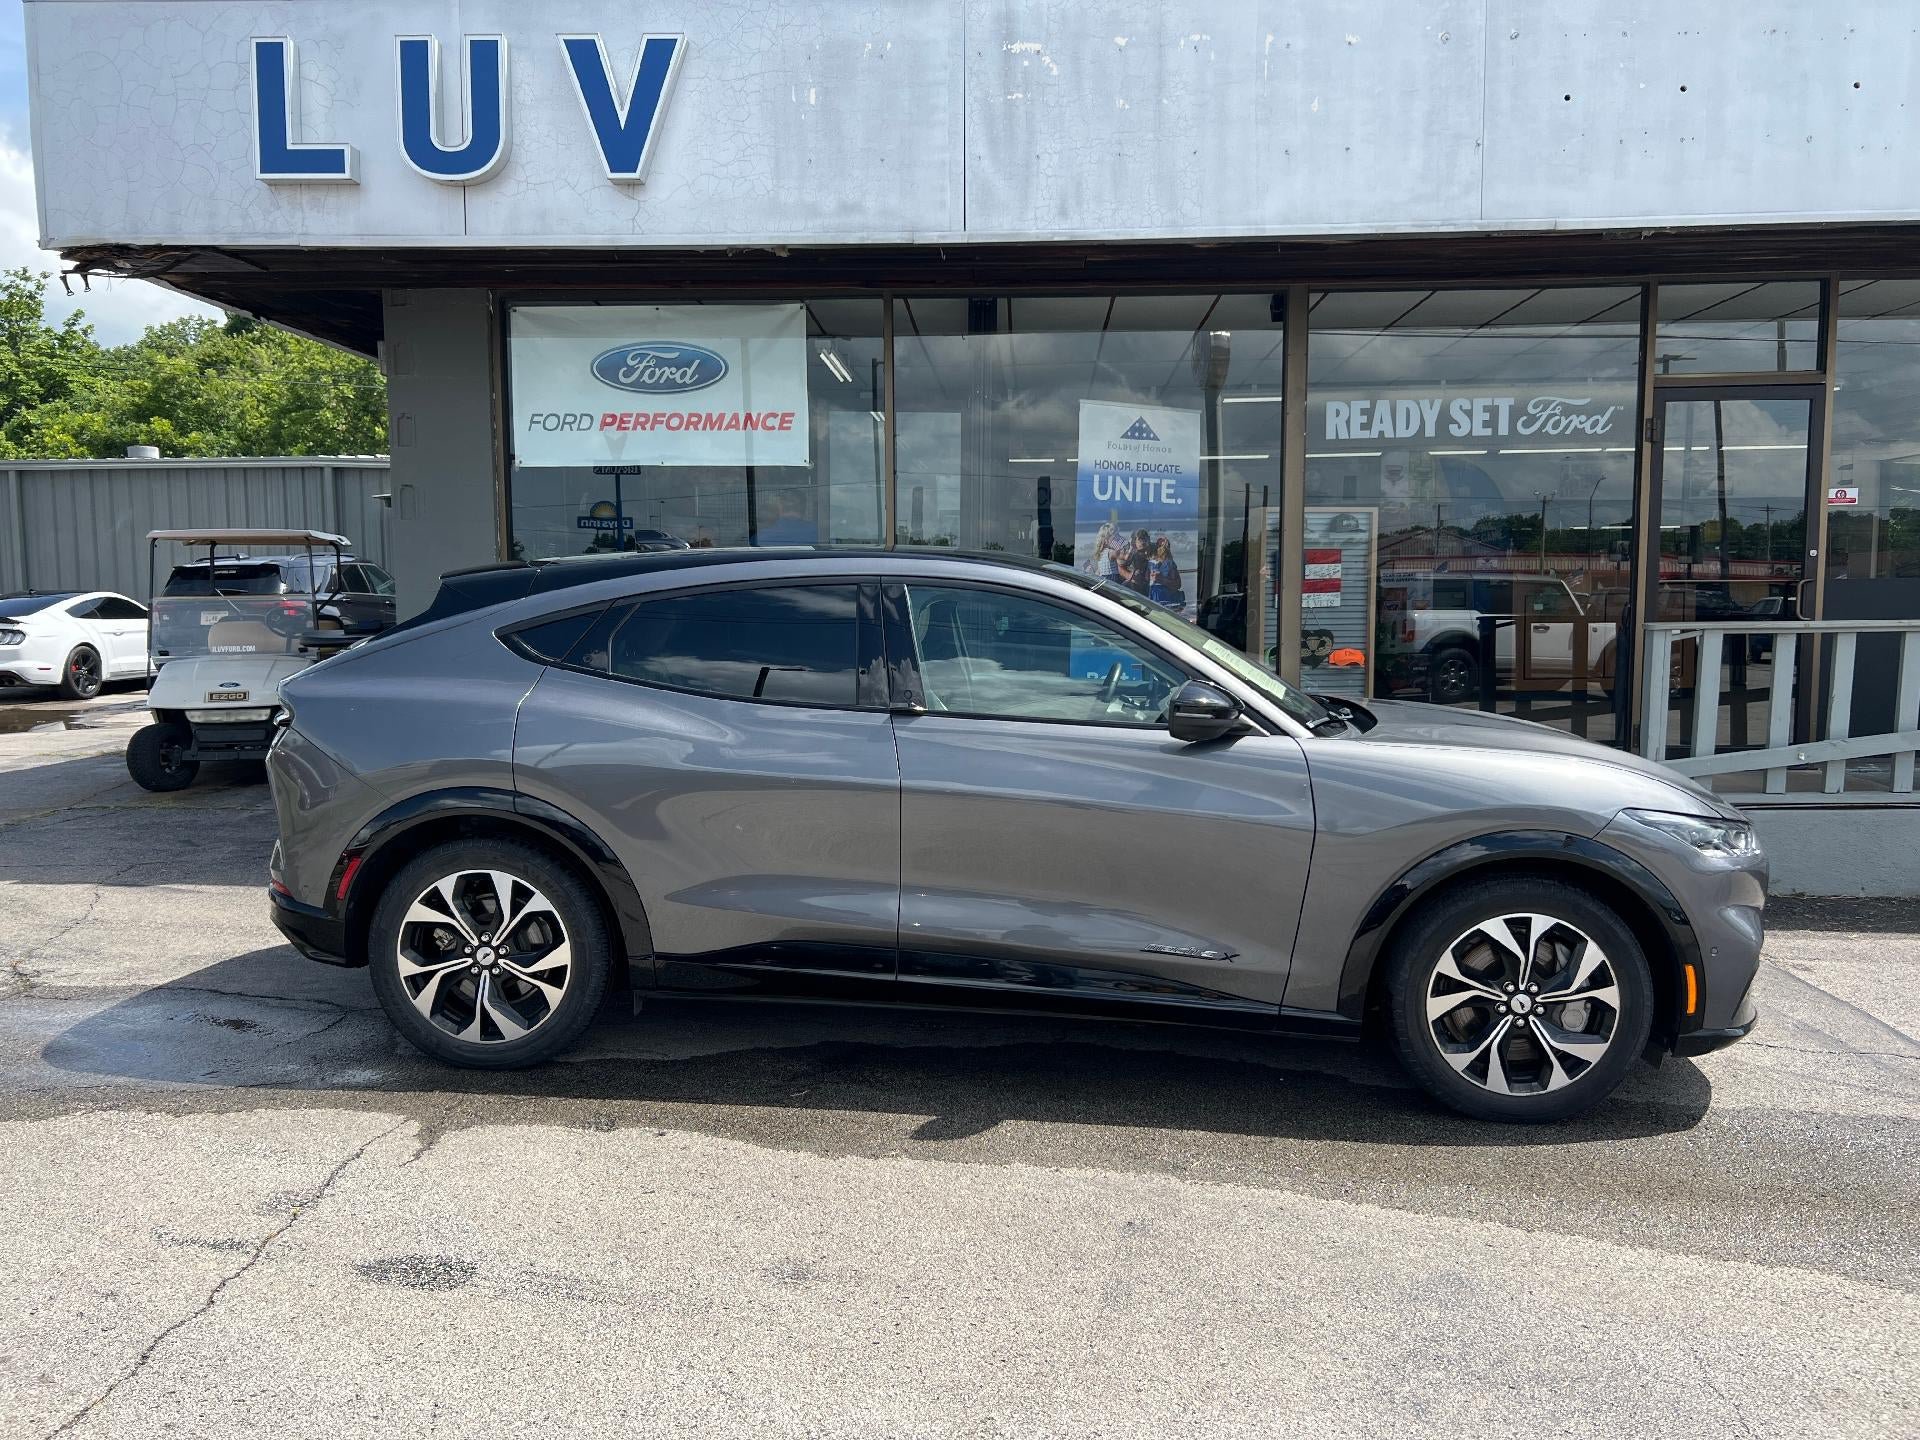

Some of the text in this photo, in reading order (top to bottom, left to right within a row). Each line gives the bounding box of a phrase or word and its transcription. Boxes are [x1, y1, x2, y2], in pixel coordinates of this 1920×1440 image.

[250, 33, 688, 185] LUV
[617, 349, 702, 385] Ford
[528, 411, 795, 432] FORD PERFORMANCE
[1325, 398, 1442, 440] READY
[1449, 397, 1515, 437] SET
[1516, 396, 1617, 436] Ford
[1133, 443, 1141, 453] of
[1094, 459, 1182, 474] HONOR. EDUCATE.
[1093, 474, 1182, 505] UNITE.
